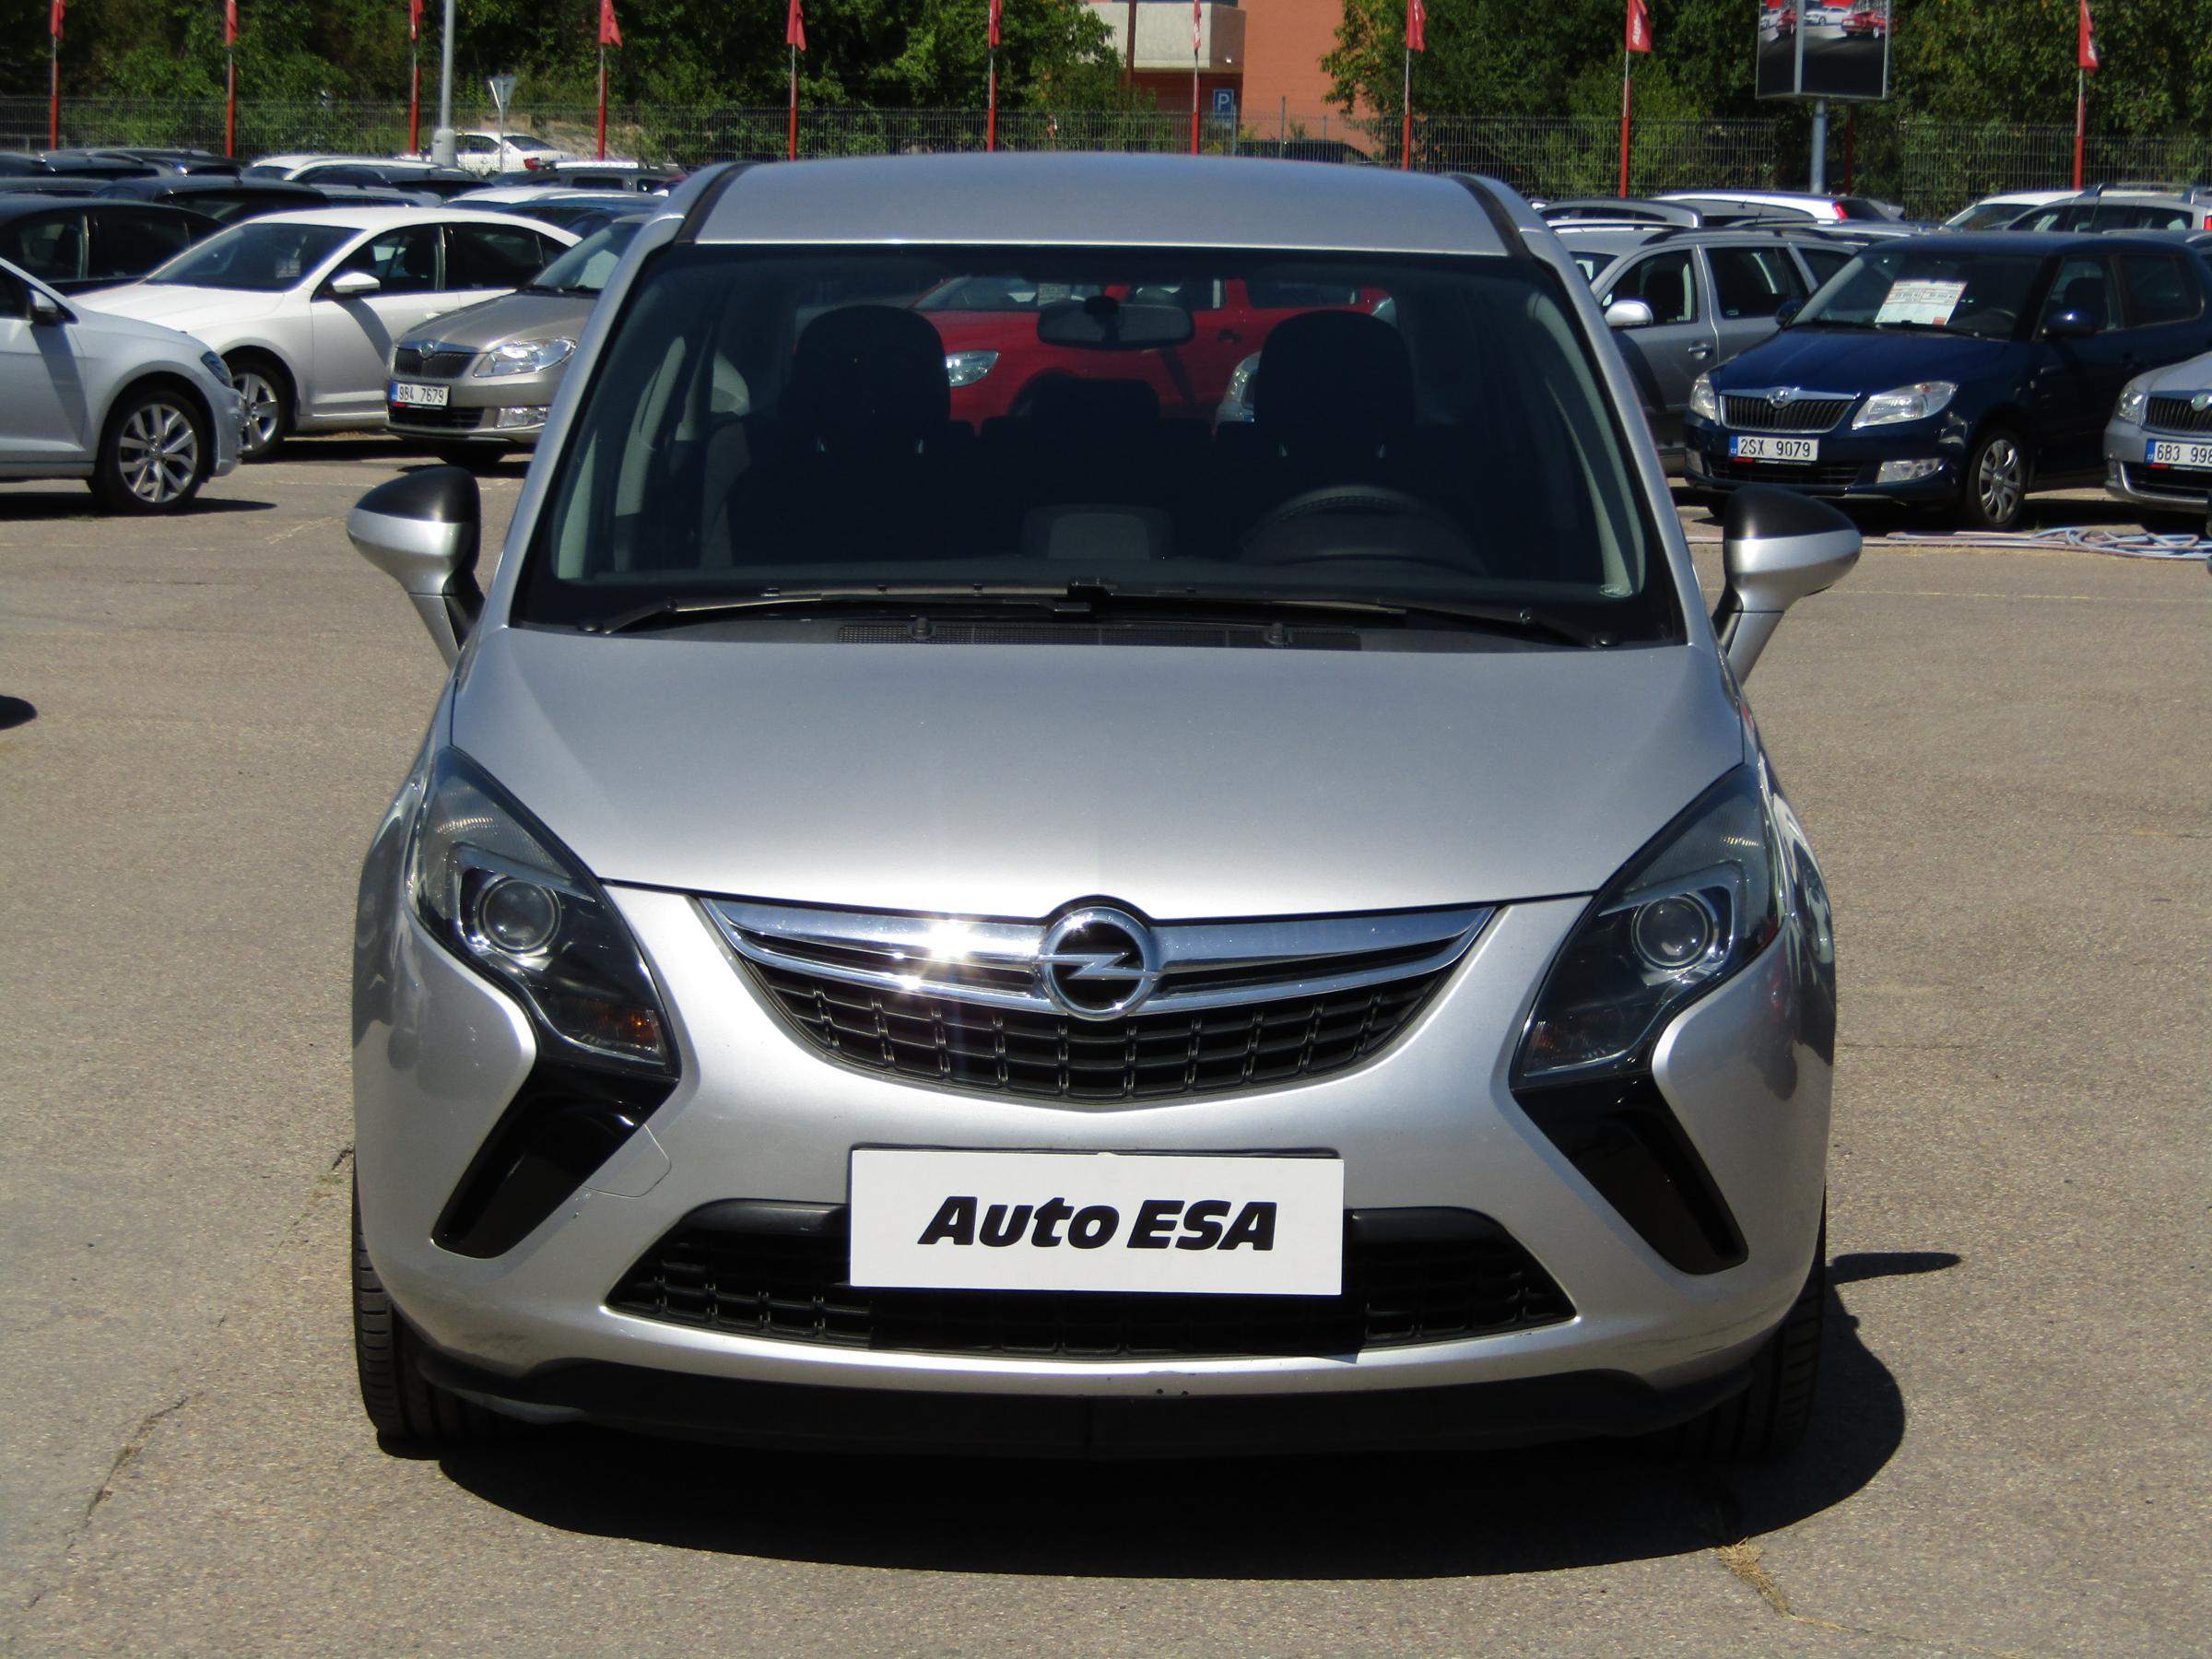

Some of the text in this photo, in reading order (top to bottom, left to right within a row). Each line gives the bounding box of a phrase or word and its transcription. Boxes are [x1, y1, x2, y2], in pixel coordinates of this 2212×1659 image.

[1218, 93, 1230, 111] P
[420, 388, 443, 403] 7679
[1741, 439, 1810, 457] 2SX 9079
[2158, 444, 2180, 461] 6B3
[917, 1196, 1277, 1251] Auto ESA
